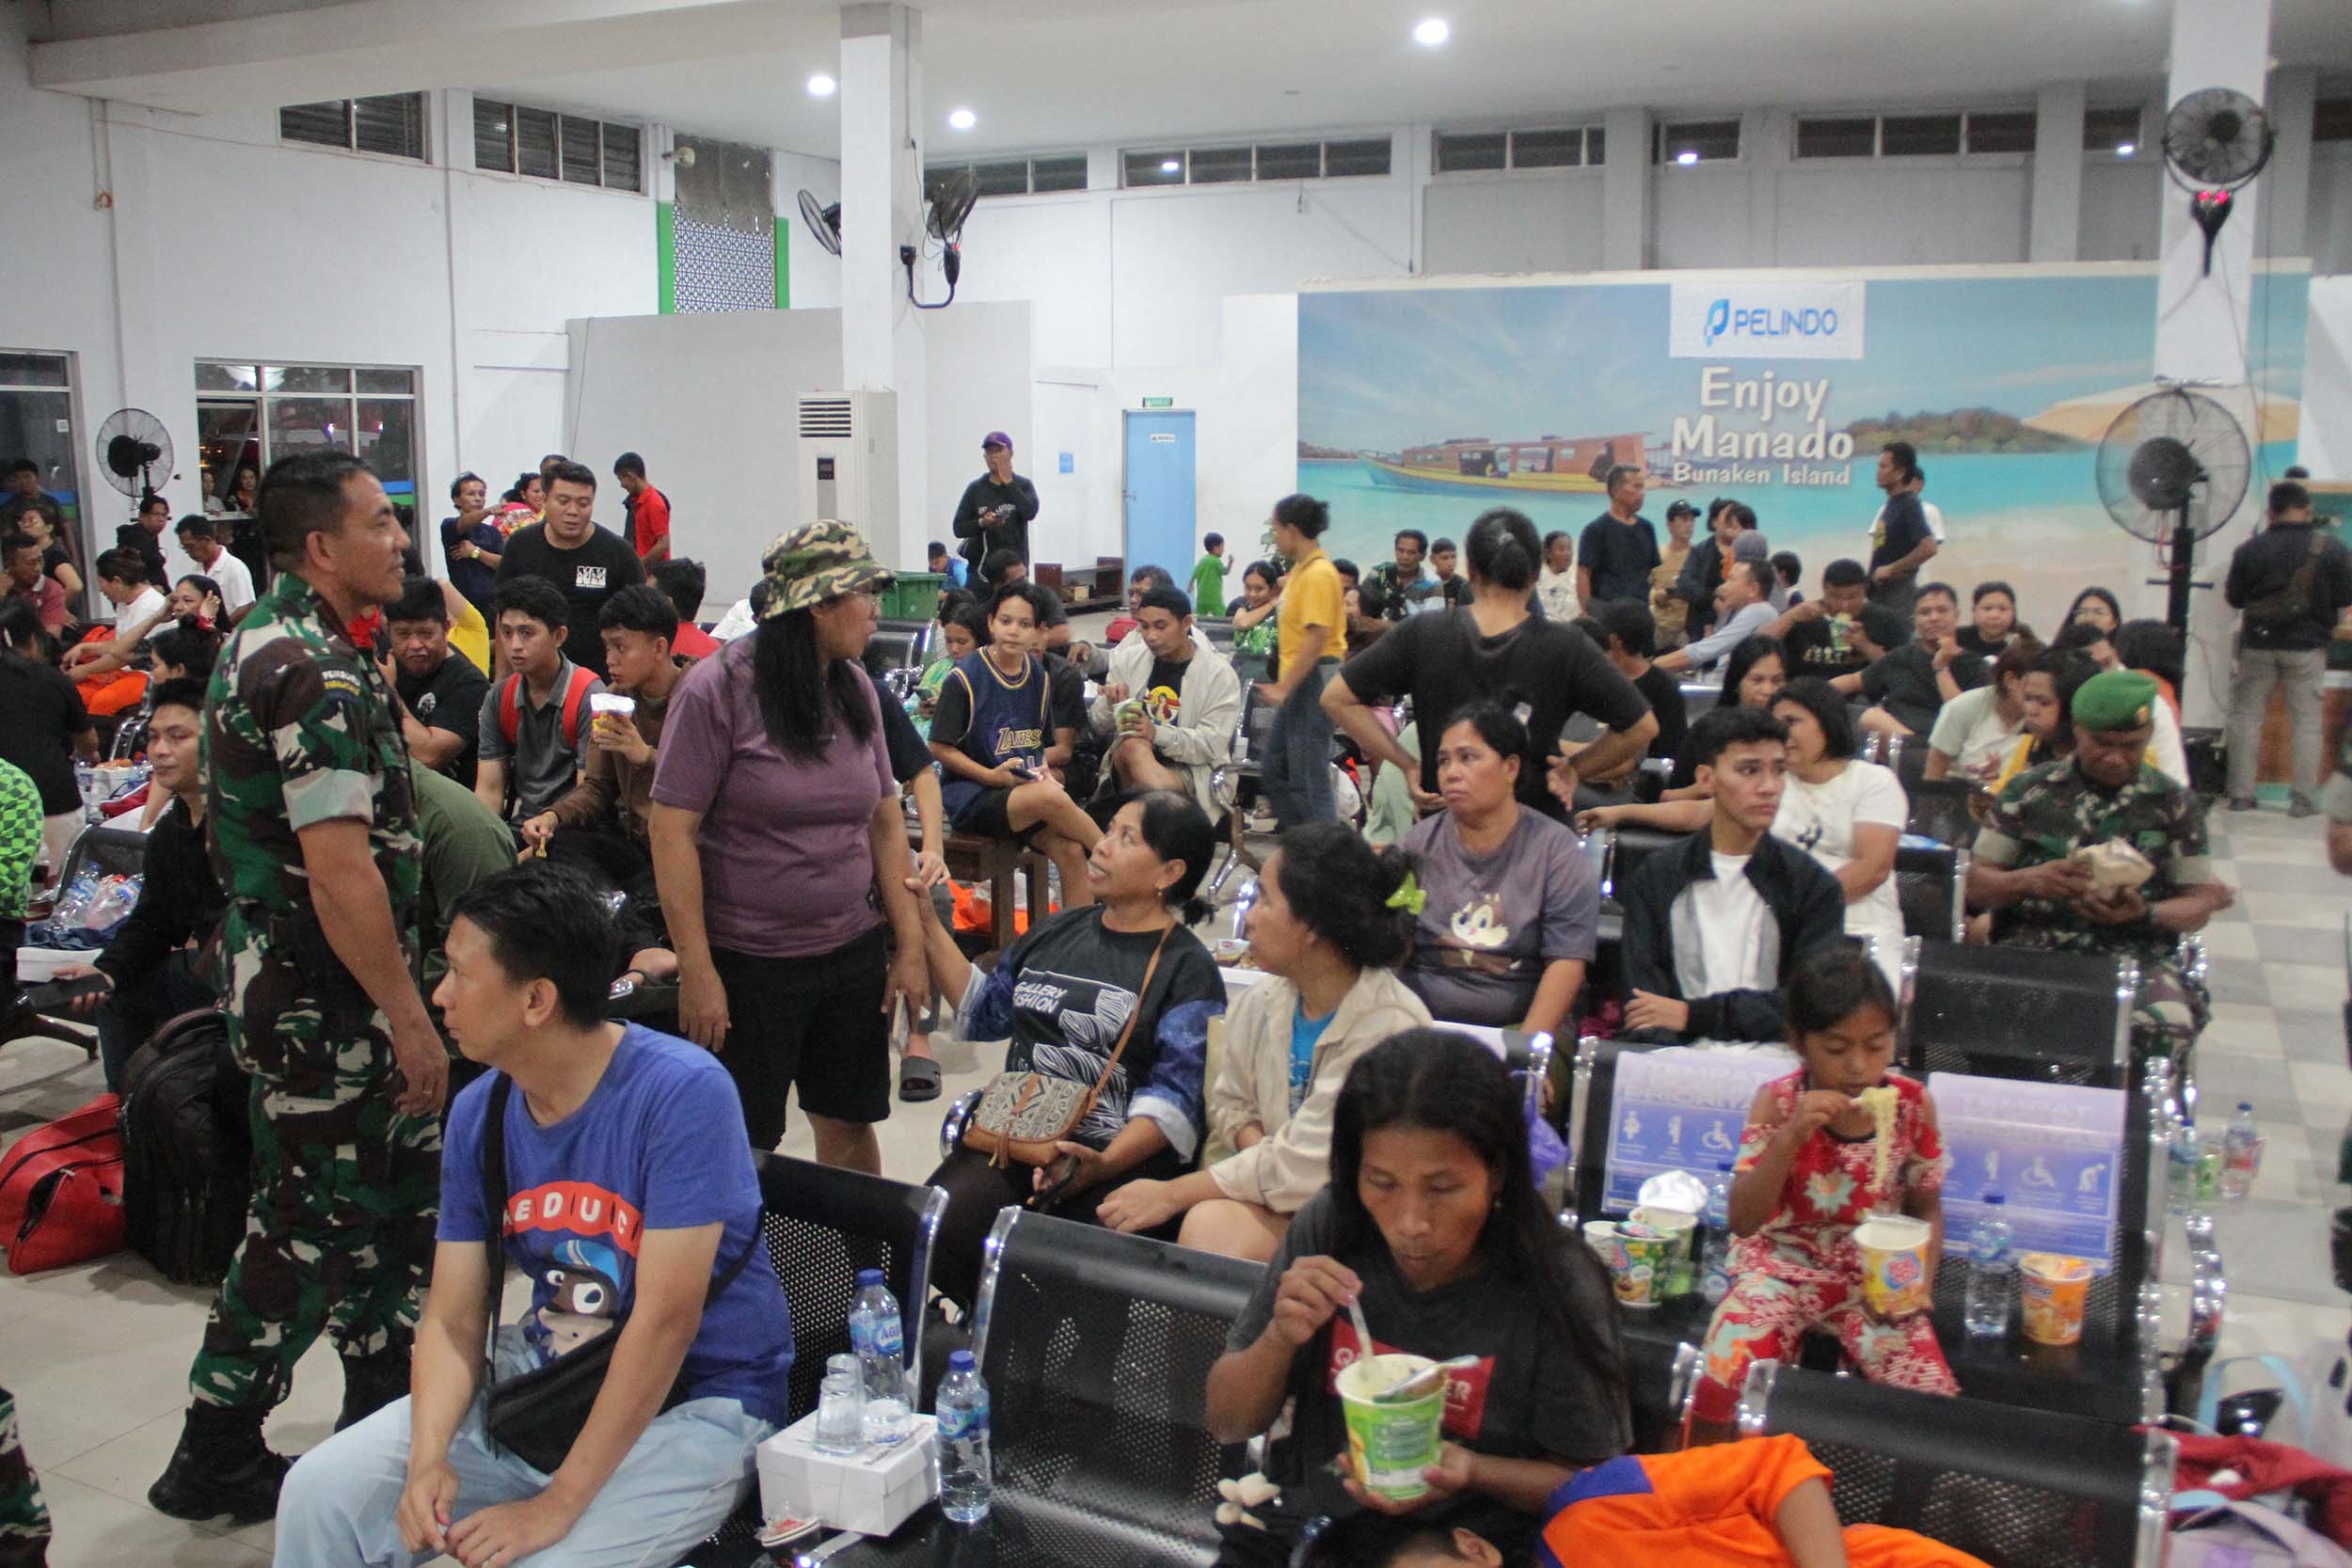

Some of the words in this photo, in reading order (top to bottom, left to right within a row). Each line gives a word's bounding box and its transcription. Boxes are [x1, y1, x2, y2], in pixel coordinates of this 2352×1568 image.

[1734, 309, 1837, 335] PELINDO
[1700, 367, 1829, 421] Enjoy
[1672, 414, 1854, 459] Manado
[1673, 462, 1771, 483] Bunaken
[1784, 465, 1851, 484] Island
[1015, 982, 1068, 999] GALLERY
